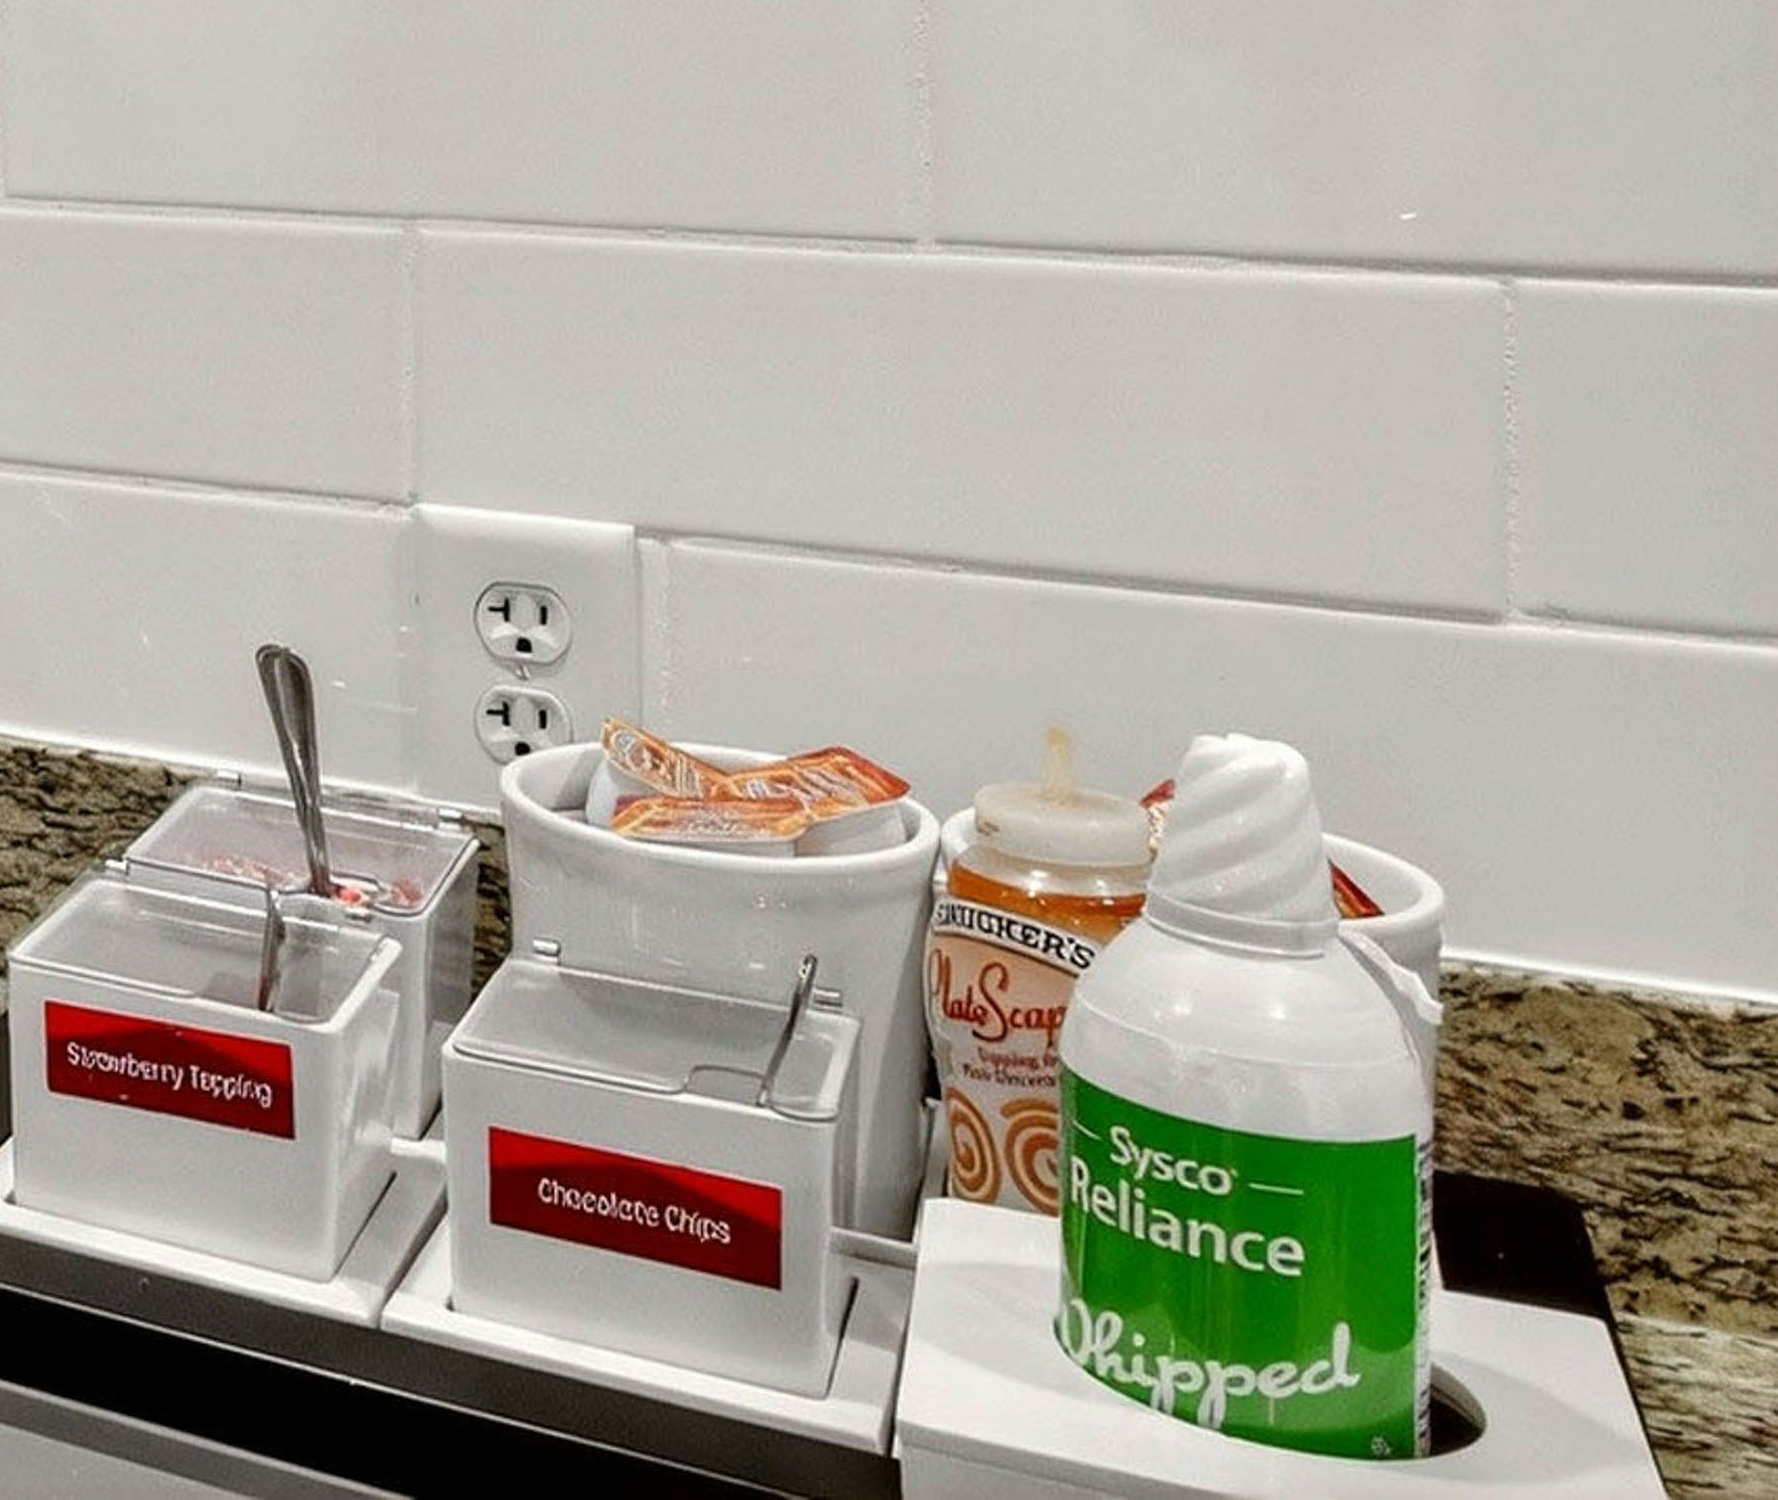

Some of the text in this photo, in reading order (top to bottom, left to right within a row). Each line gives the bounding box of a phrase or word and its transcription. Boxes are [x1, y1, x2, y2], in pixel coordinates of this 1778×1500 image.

[67, 1041, 273, 1109] Strawberry Topping
[1109, 1125, 1233, 1197] Sysco
[537, 1176, 731, 1245] Chocolate Chips
[1070, 1155, 1305, 1278] Reliance
